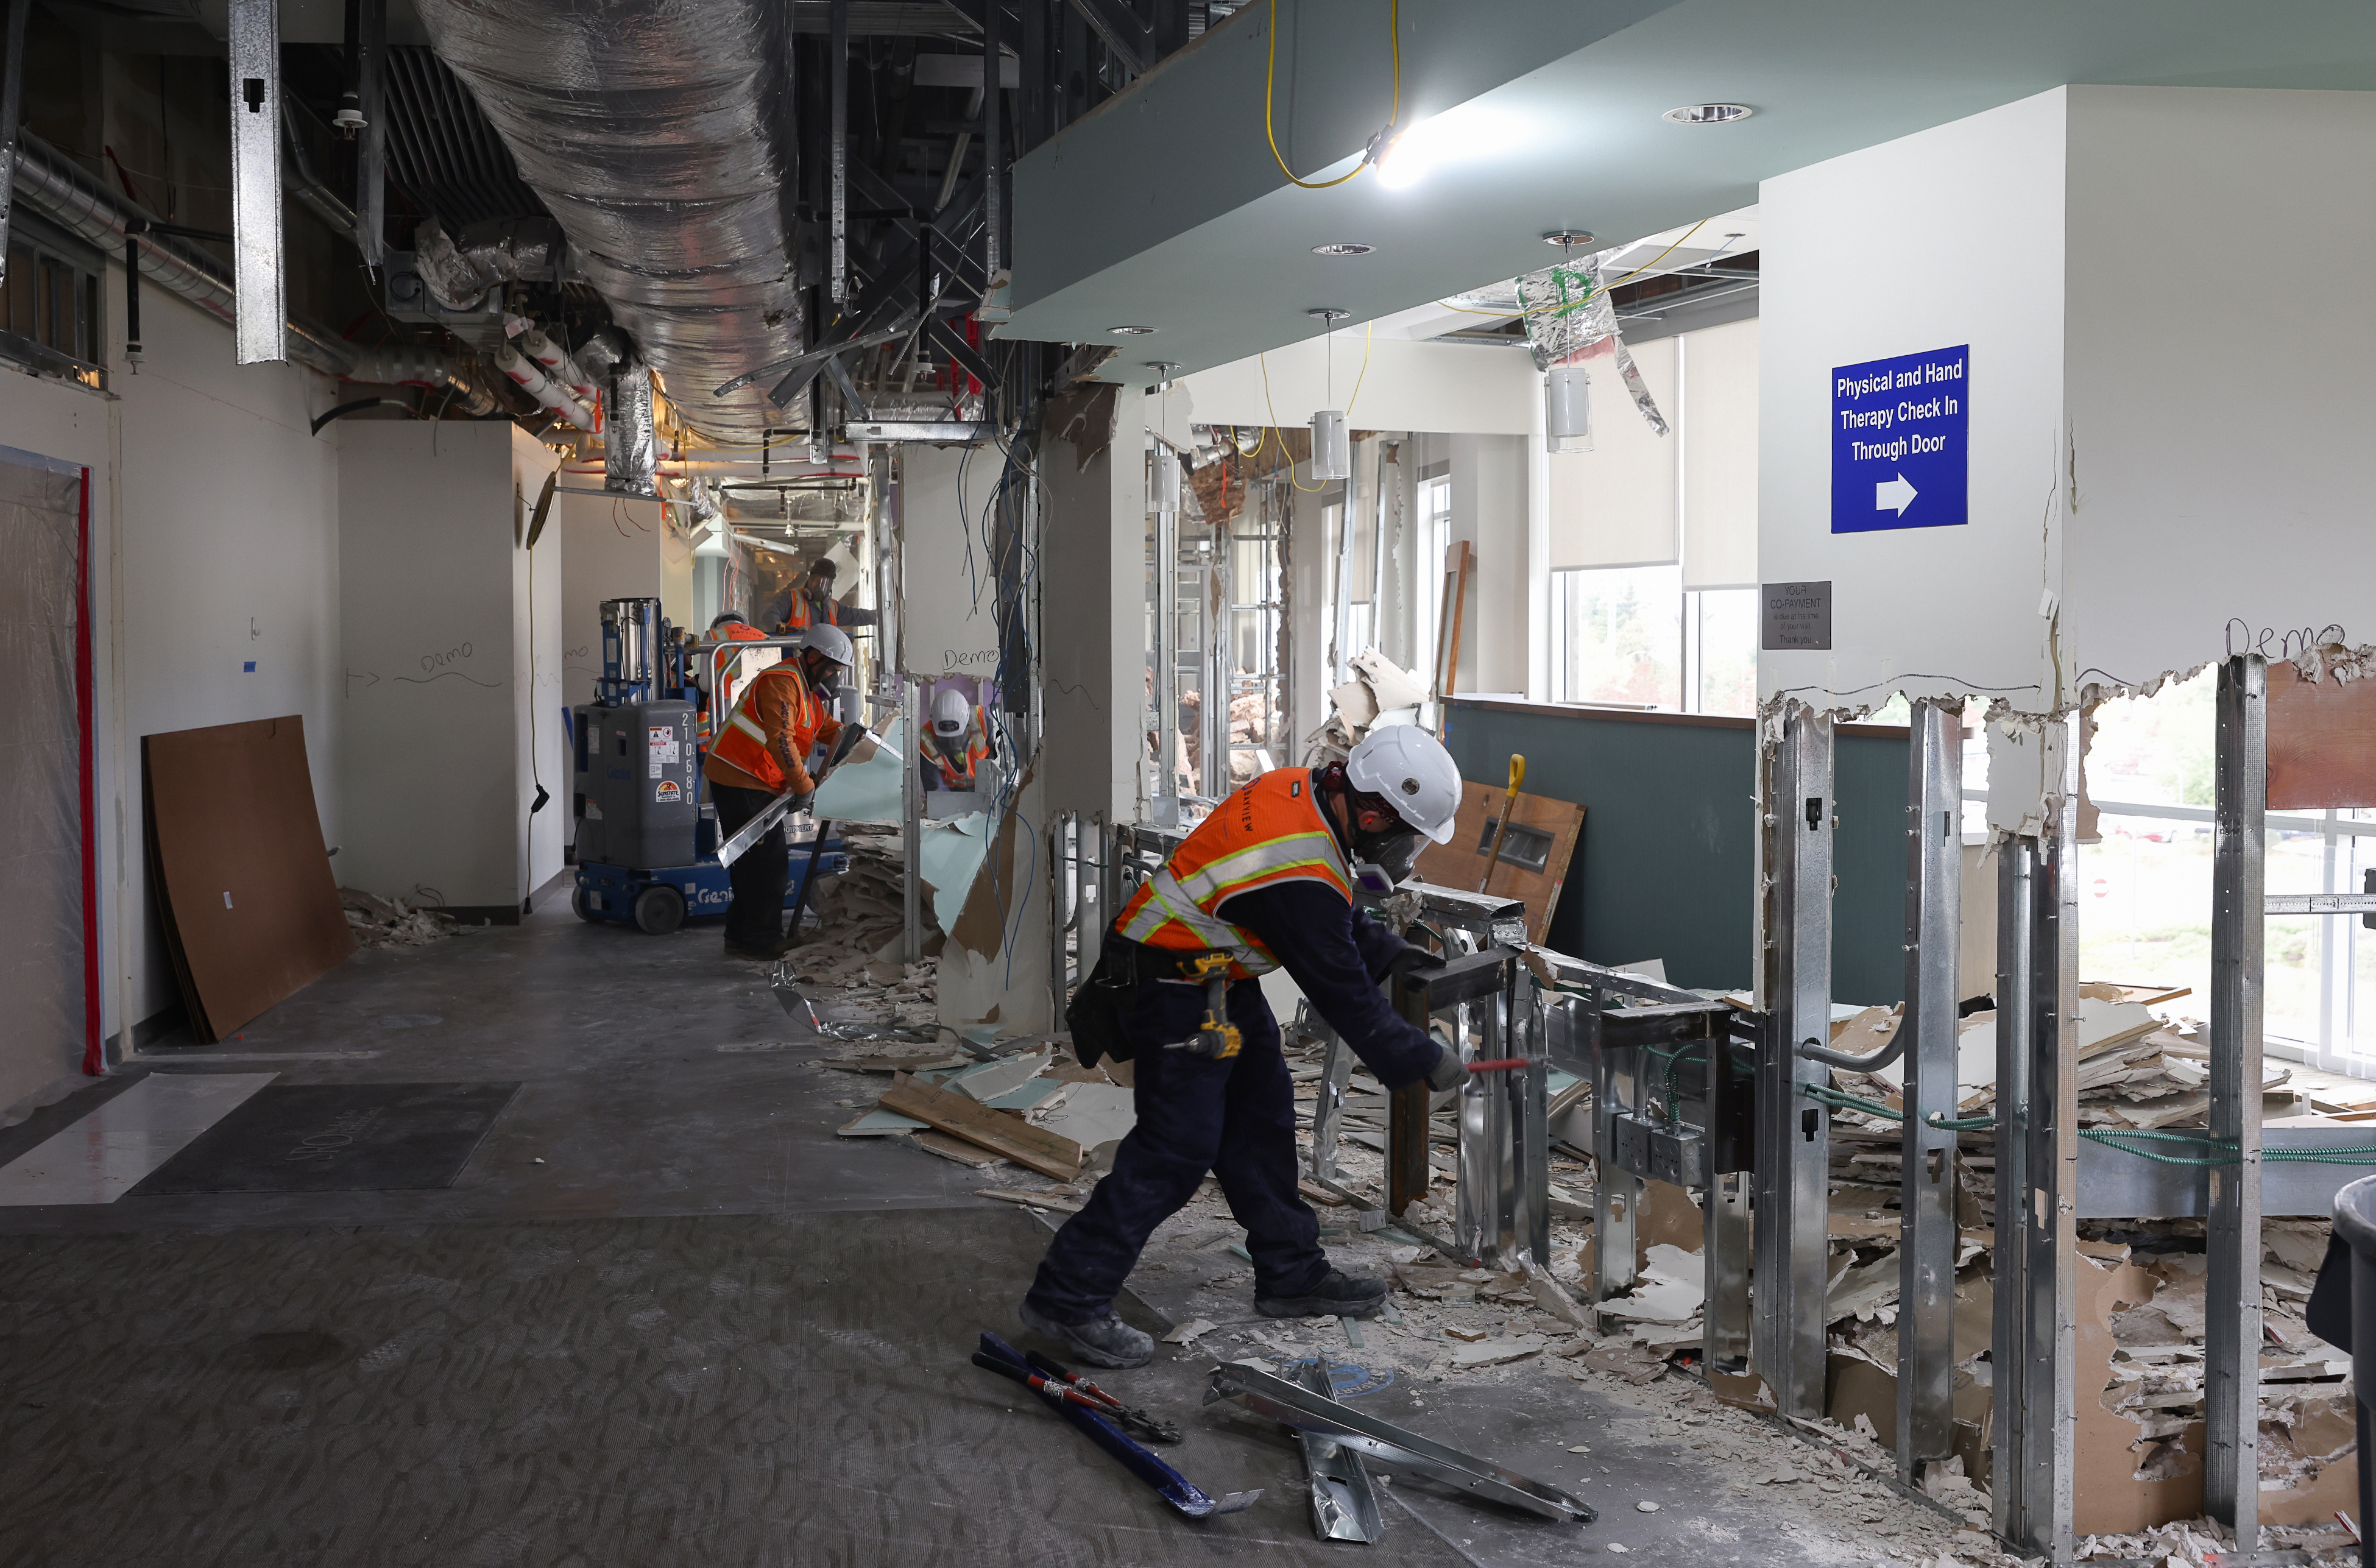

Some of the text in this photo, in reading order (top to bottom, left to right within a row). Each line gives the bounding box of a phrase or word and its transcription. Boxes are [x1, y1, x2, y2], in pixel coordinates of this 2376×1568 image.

[1837, 358, 1962, 400] Physical and Hand
[1841, 395, 1957, 429] Therapy Check In
[1852, 434, 1946, 461] Through Door
[1784, 585, 1806, 595] YOUR
[1770, 598, 1821, 609] CO-PAYMENT
[1780, 635, 1811, 645] Thank you
[2225, 618, 2346, 659] Demo
[943, 649, 999, 670] Demo
[682, 713, 693, 805] 210680
[1242, 789, 1253, 832] BAYVIEW
[784, 824, 814, 833] UIPMENT
[698, 886, 735, 904] Geni
